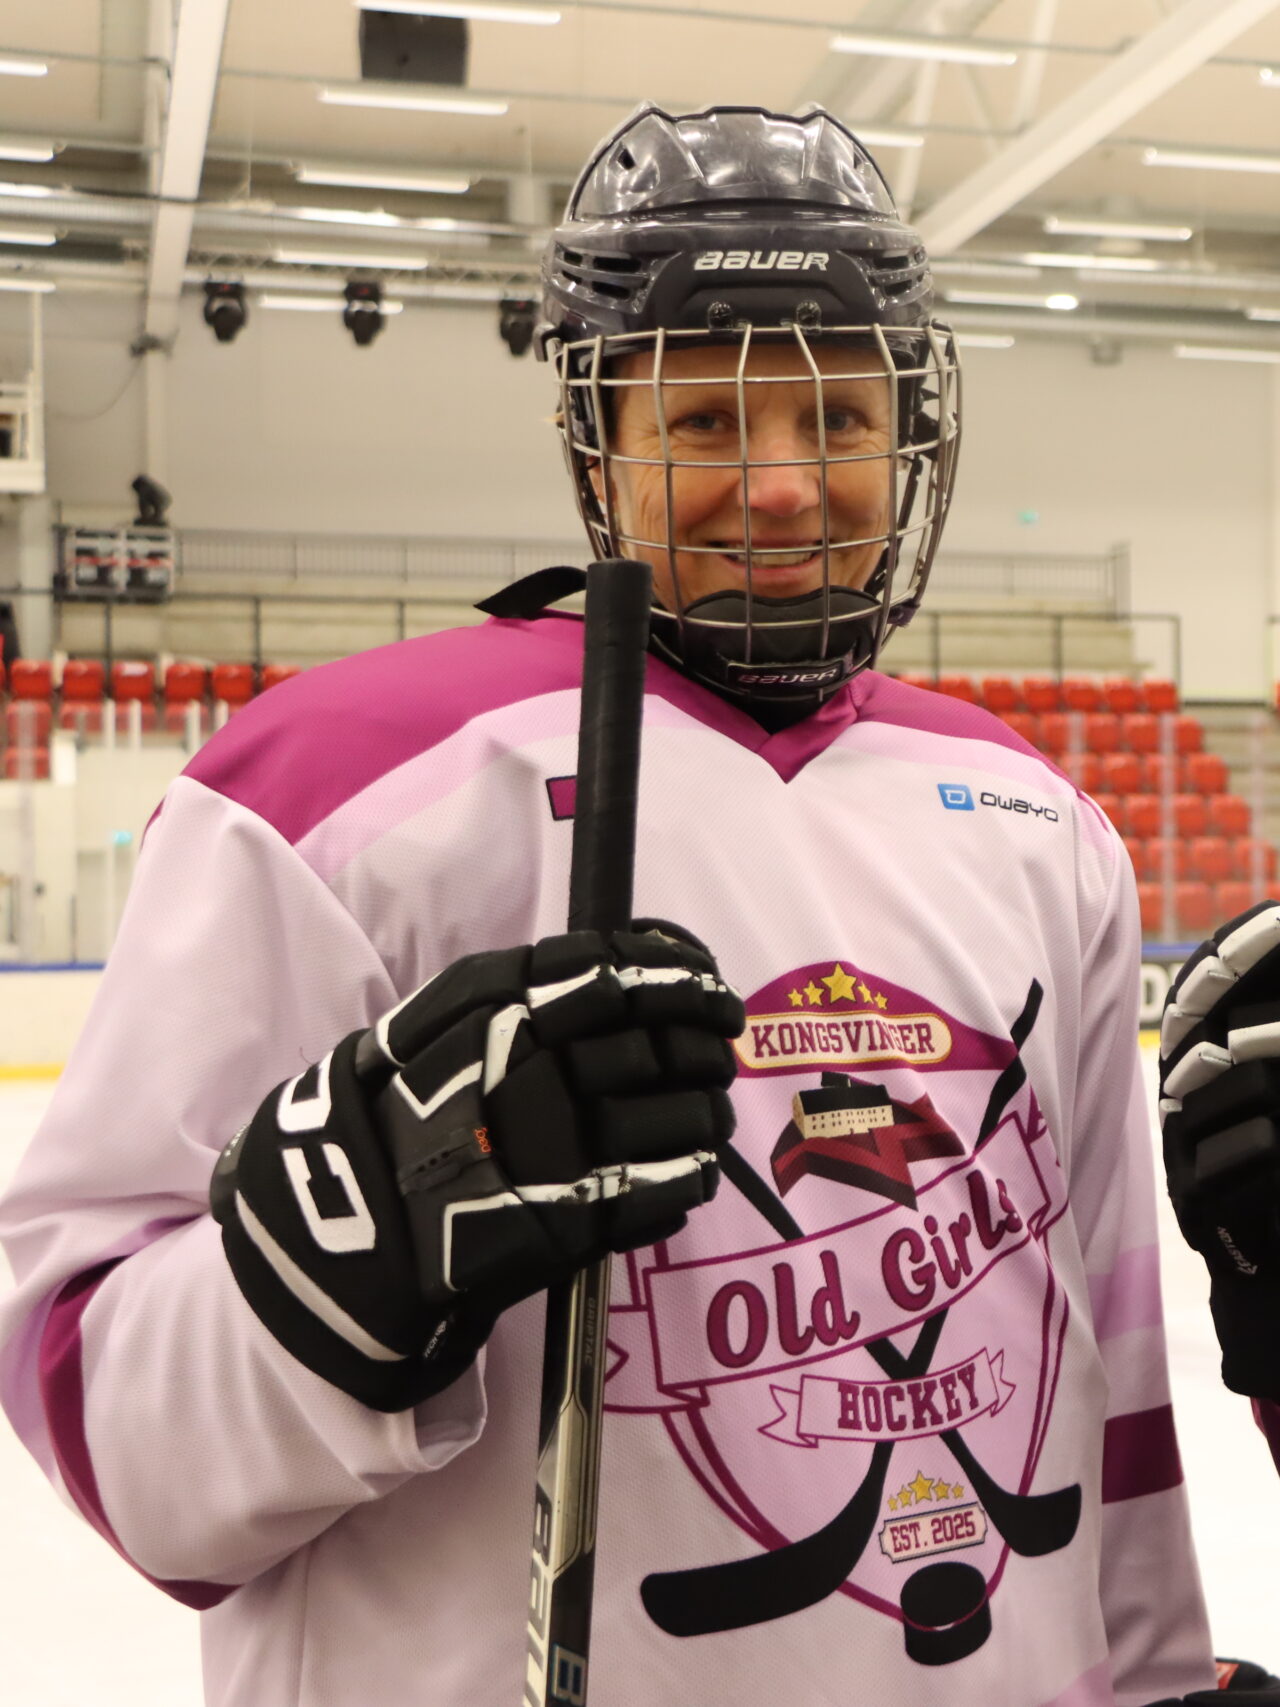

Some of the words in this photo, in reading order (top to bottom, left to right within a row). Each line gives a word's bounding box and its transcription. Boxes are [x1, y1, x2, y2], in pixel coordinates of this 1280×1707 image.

[694, 250, 829, 271] BAUER
[739, 668, 837, 684] BAUER
[750, 1020, 936, 1059] KONGSVINGER
[705, 1249, 861, 1369] Old
[880, 1168, 1024, 1312] Girls
[837, 1362, 981, 1433] HOCKEY
[889, 1522, 928, 1553] EST.
[931, 1510, 977, 1544] 2025
